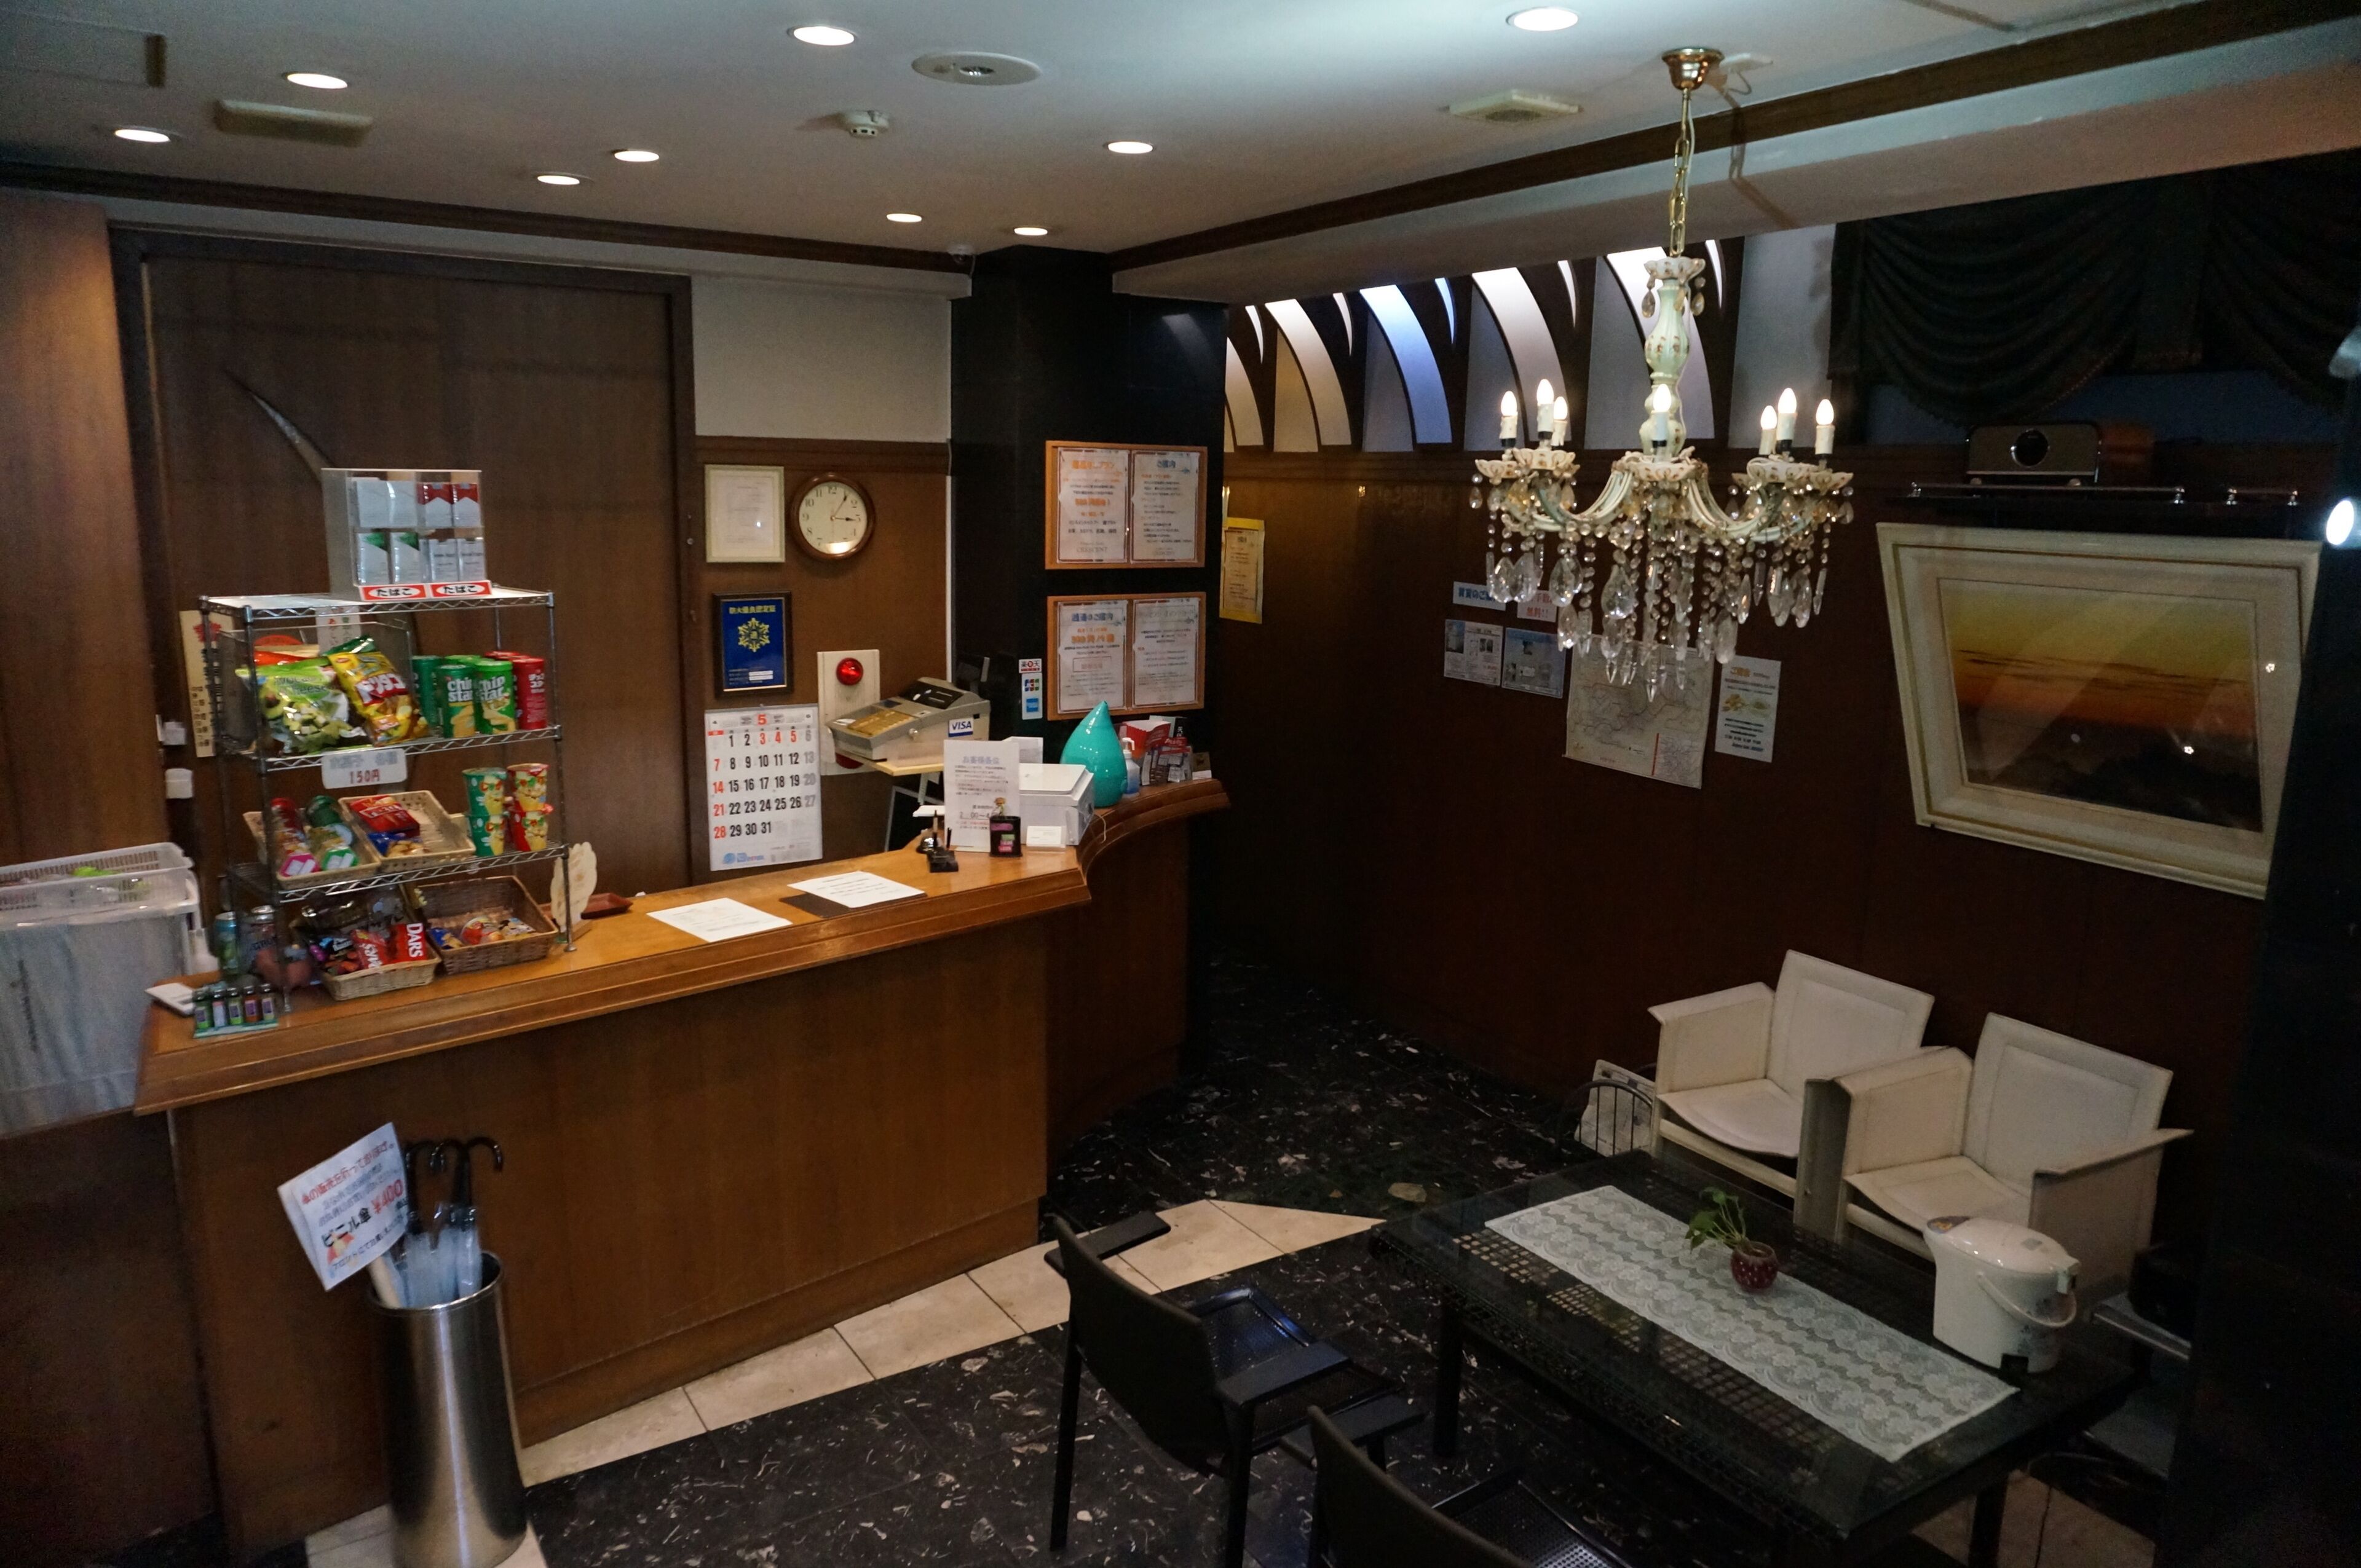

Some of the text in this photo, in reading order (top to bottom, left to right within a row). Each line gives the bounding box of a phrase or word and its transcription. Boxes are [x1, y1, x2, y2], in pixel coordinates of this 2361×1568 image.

[376, 588, 413, 597] たばこ
[444, 585, 478, 594] たばこ
[757, 714, 767, 726] 5
[952, 721, 972, 730] VISA
[729, 735, 734, 747] 1
[745, 734, 750, 746] 2
[759, 733, 765, 745] 3
[775, 731, 781, 743] 4
[791, 730, 797, 743] 5
[714, 758, 720, 771] 7
[730, 757, 736, 770] 8
[745, 756, 751, 768] 9
[759, 755, 769, 767] 10
[773, 754, 783, 766] 11
[788, 752, 799, 765] 12
[349, 769, 380, 784] 150円
[713, 781, 724, 794] 14
[729, 780, 739, 792] 15
[744, 778, 754, 791] 16
[759, 777, 769, 789] 17
[775, 776, 785, 788] 18
[790, 774, 799, 787] 19
[713, 804, 724, 816] 21
[729, 802, 740, 815] 22
[745, 801, 756, 813] 23
[759, 799, 771, 812] 24
[775, 798, 786, 810] 25
[790, 797, 801, 809] 26
[714, 822, 772, 839] 28 29 30 31
[405, 923, 424, 958] DARS
[371, 1179, 404, 1215] ¥400
